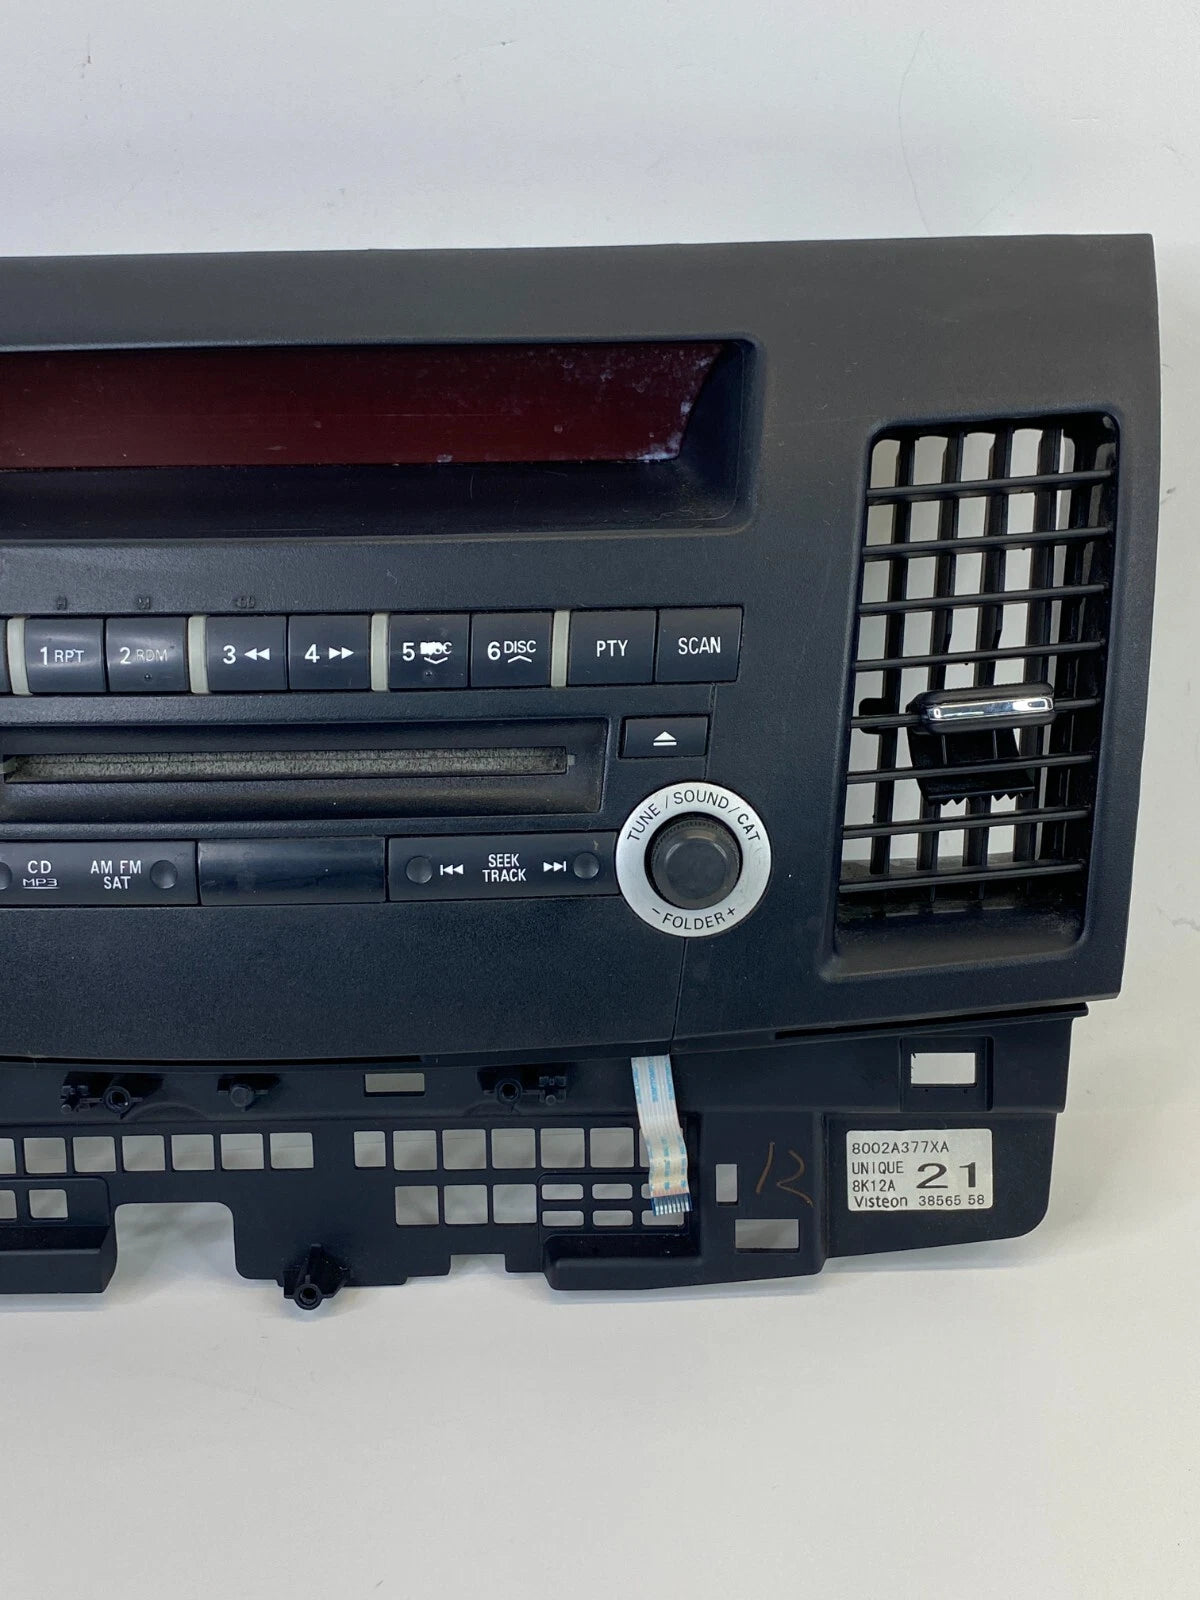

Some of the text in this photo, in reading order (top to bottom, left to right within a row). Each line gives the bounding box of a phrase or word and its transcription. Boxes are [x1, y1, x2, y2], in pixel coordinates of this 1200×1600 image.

[304, 644, 320, 663] 4
[402, 642, 415, 661] 5
[487, 640, 537, 660] 6 DISC
[596, 640, 629, 657] PTY
[678, 637, 721, 655] SCAN
[40, 646, 85, 665] 1 RPT
[120, 647, 168, 664] 2 RDM
[223, 645, 236, 664] 3
[27, 860, 51, 874] CD
[90, 860, 142, 875] AM FM
[488, 854, 520, 868] SEEK
[22, 878, 58, 888] MP3
[103, 876, 131, 890] SAT
[482, 868, 527, 883] TRACK
[852, 1140, 949, 1155] 8002A377XA
[852, 1160, 904, 1175] UNIQUE
[852, 1179, 896, 1193] 8K12A
[854, 1194, 985, 1209] Visteon 38565 58
